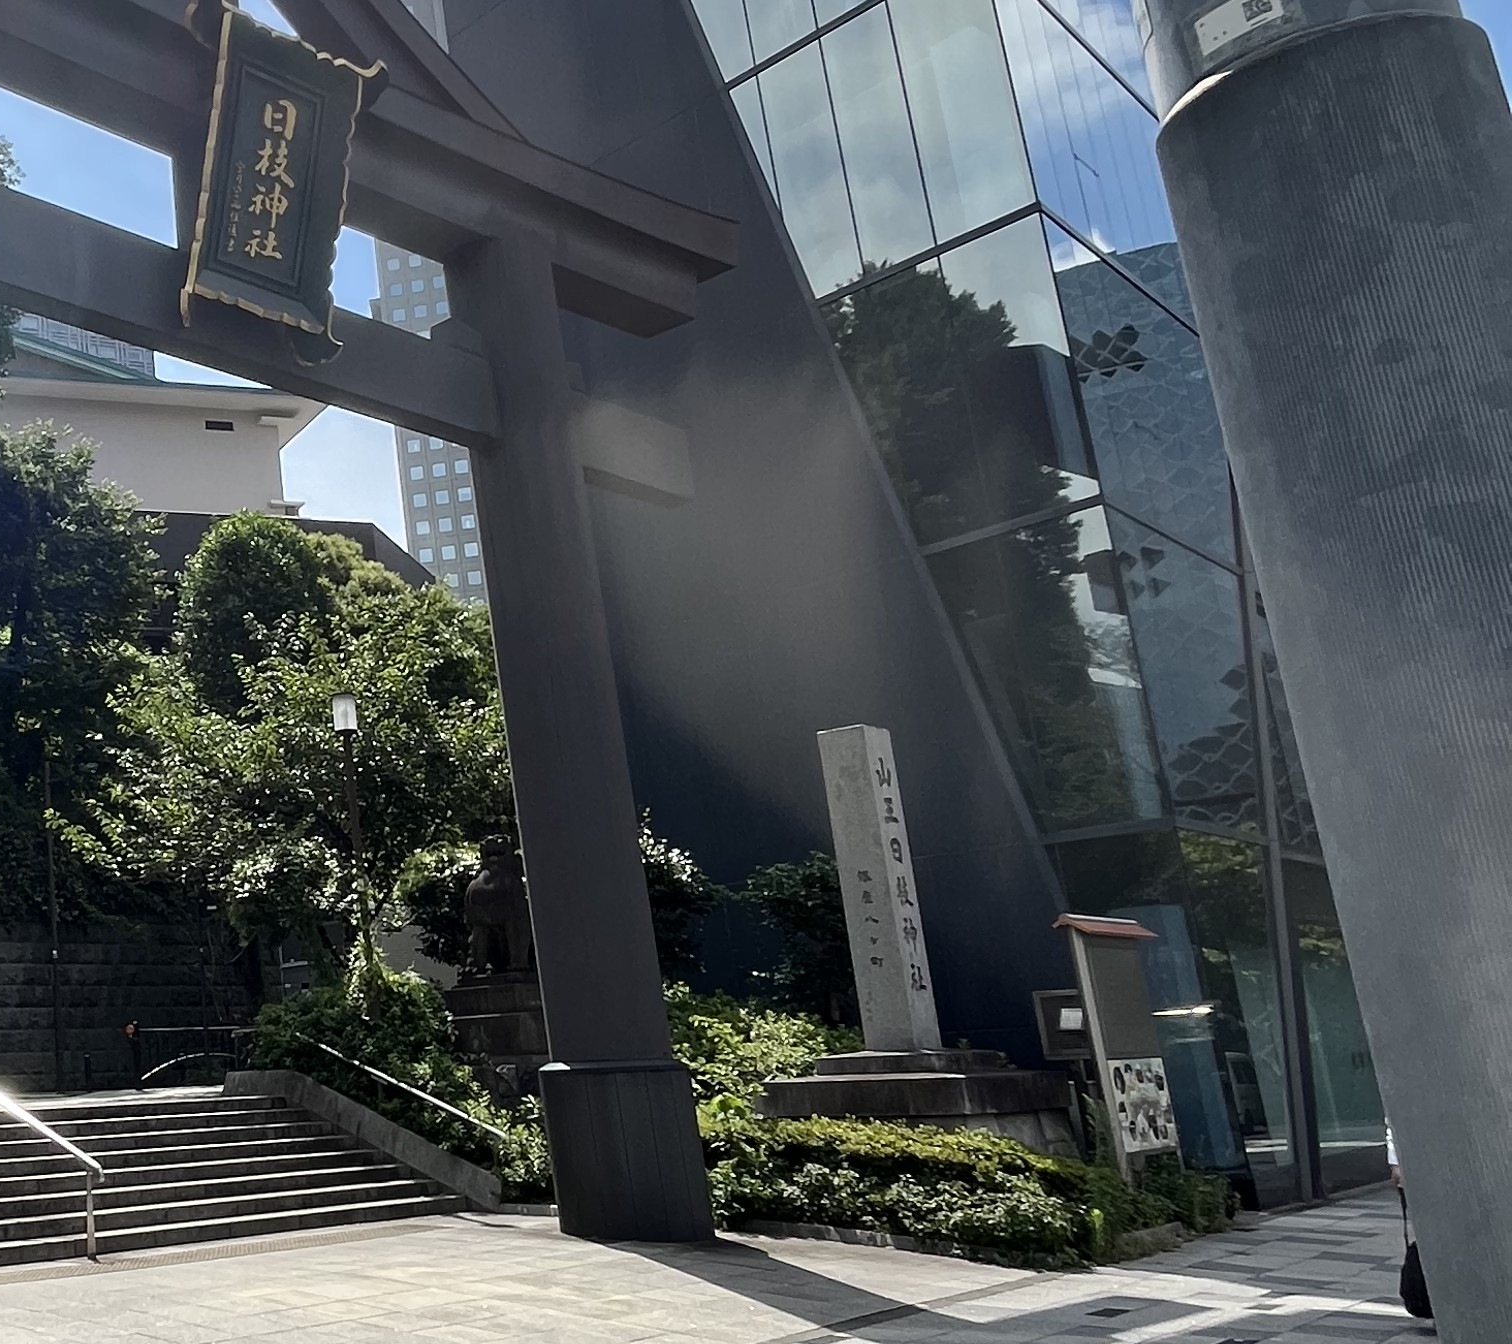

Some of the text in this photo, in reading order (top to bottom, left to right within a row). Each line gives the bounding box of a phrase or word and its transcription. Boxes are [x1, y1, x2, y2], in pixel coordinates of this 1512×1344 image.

[244, 99, 297, 260] 日枝神社
[875, 756, 928, 992] 山王日枝神社
